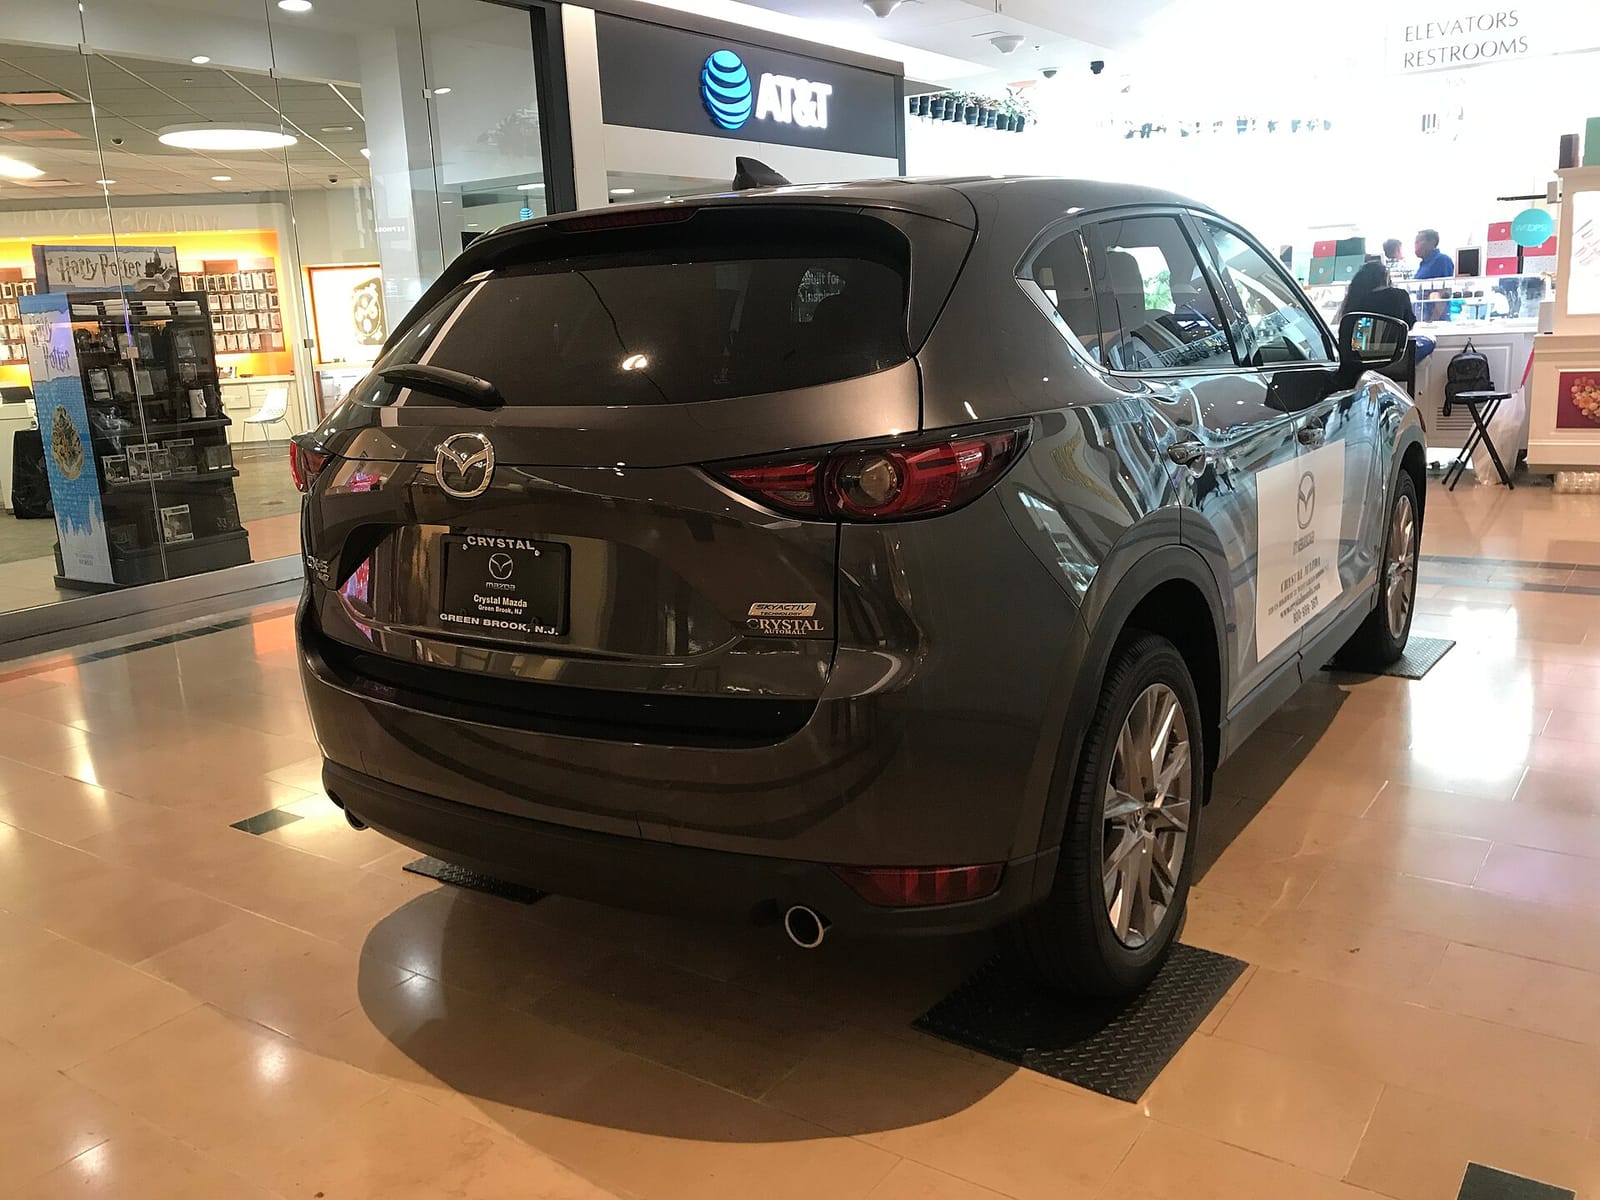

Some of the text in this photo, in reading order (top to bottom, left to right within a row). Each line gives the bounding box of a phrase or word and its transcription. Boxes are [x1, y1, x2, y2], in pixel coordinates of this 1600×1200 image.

[1405, 10, 1519, 42] ELEVATORS
[1404, 36, 1528, 69] RESTROOMS
[755, 72, 832, 128] AT&T
[56, 253, 142, 284] Harry Potter
[466, 535, 536, 551] CRYSTAL
[485, 581, 516, 592] mazda
[473, 594, 528, 608] Crystal Mazda
[439, 613, 559, 636] GREEN BROOK, N.J.
[746, 618, 824, 631] CRYSTAL
